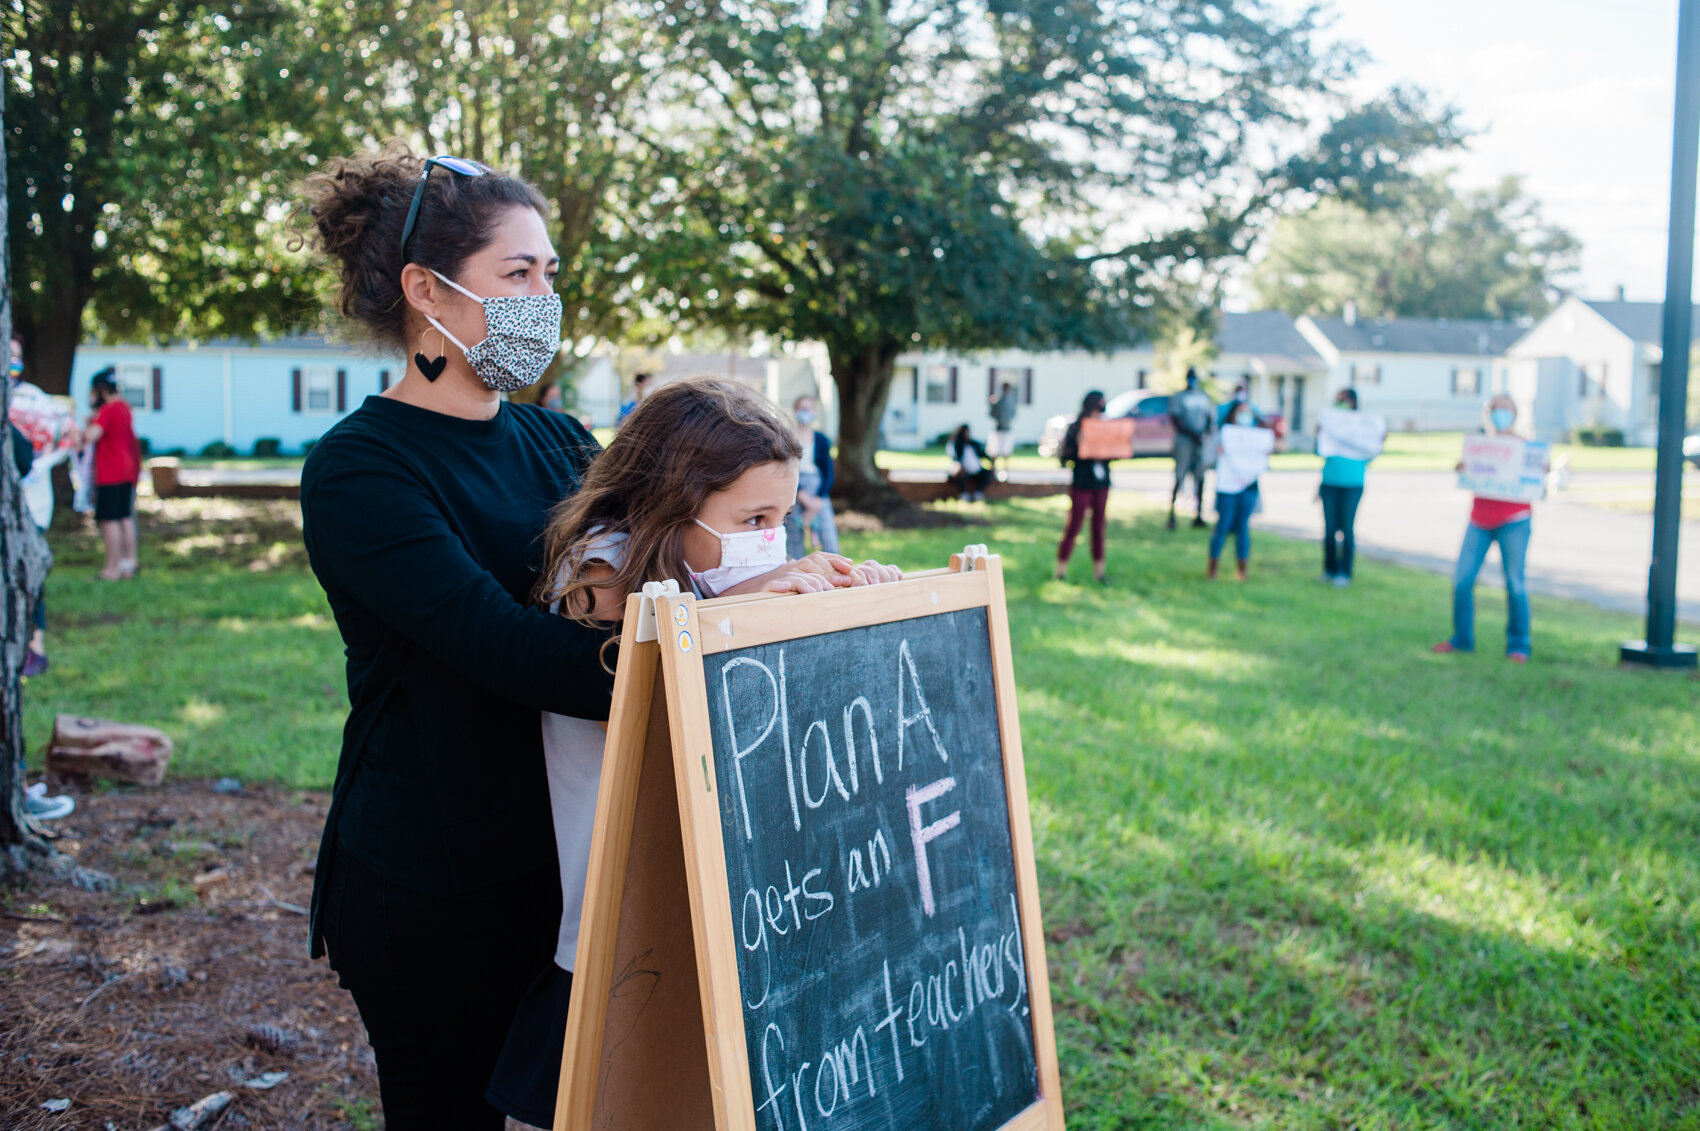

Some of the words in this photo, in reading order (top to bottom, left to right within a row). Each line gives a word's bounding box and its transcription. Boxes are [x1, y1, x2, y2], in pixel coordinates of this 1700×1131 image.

[722, 648, 883, 842] Plan
[898, 637, 948, 772] A
[742, 859, 834, 1010] gets
[848, 828, 891, 893] an
[905, 776, 961, 919] F
[756, 1022, 876, 1131] from
[874, 893, 1030, 1084] teachers!
